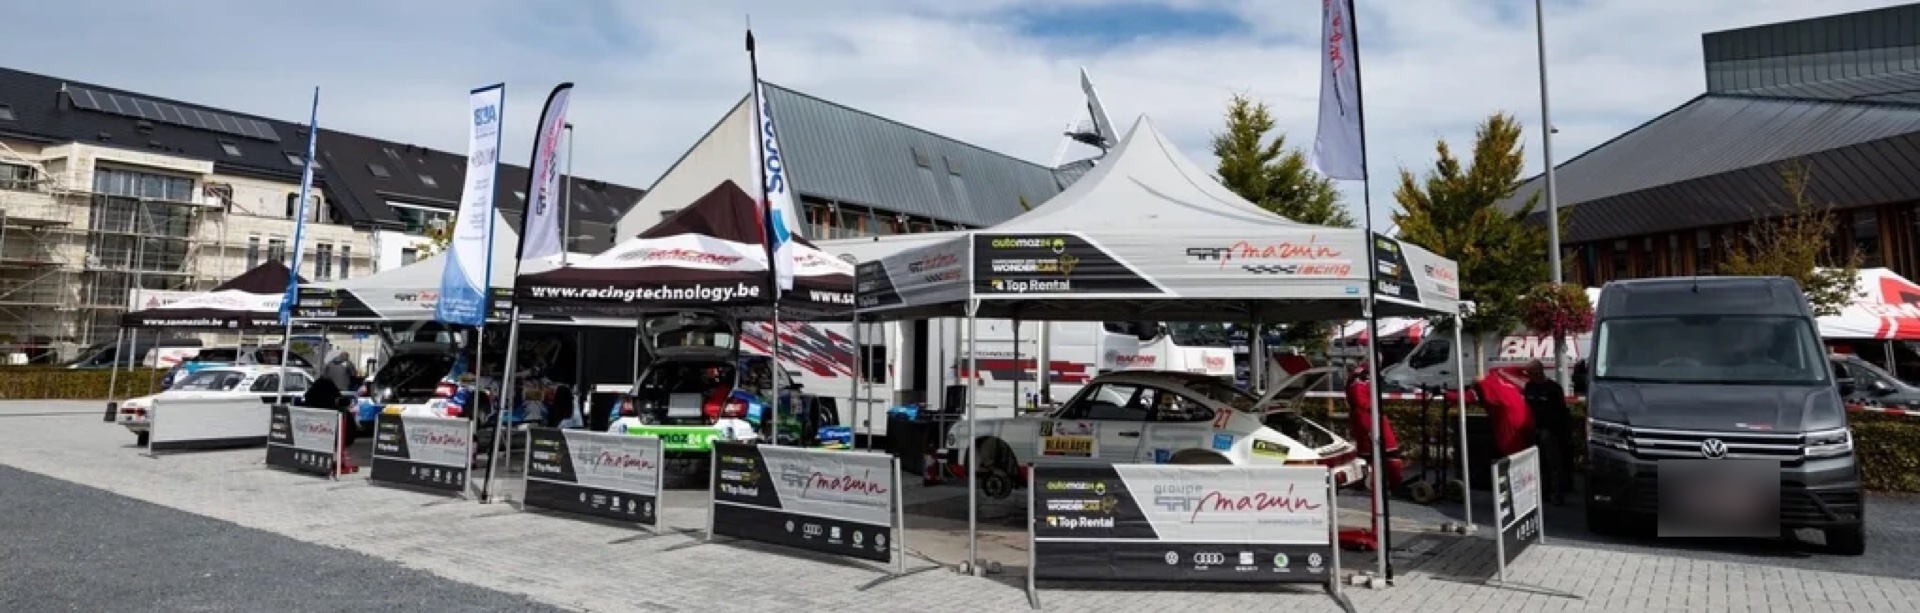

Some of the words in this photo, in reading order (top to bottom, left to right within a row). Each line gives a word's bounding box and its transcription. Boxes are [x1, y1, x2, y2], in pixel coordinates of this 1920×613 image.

[1296, 264, 1351, 277] racing
[531, 281, 760, 302] www.racingtechnology.be
[1005, 280, 1028, 293] Top
[1029, 280, 1070, 291] Rental
[1115, 355, 1156, 365] RACING
[1212, 407, 1232, 429] 27
[1154, 485, 1203, 496] groupe
[1057, 516, 1077, 529] Top
[1078, 516, 1115, 528] Rental
